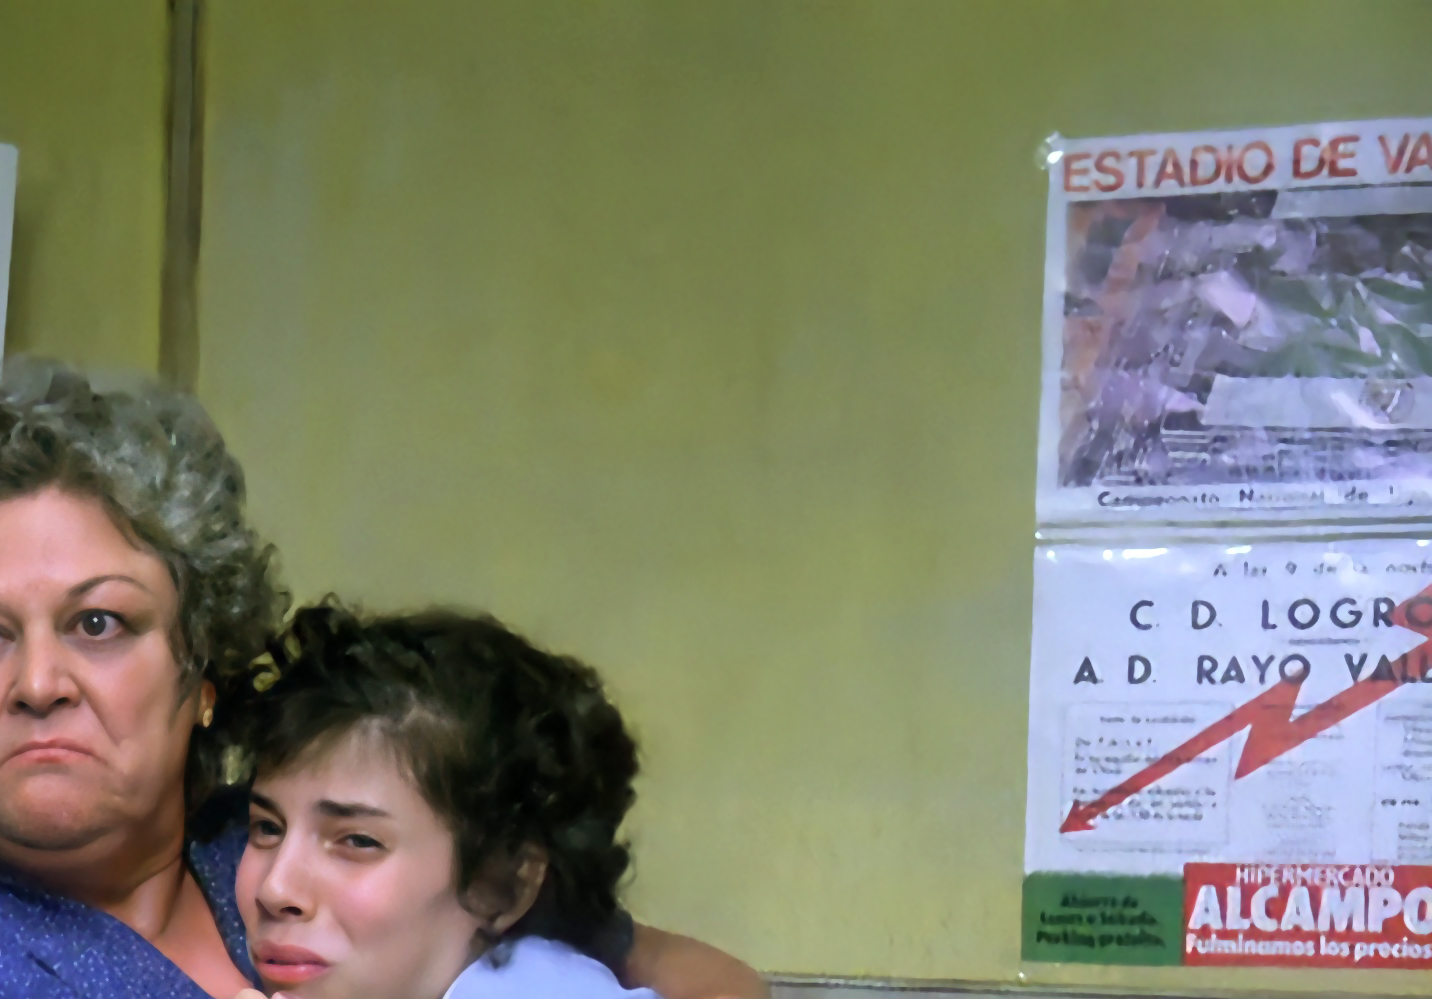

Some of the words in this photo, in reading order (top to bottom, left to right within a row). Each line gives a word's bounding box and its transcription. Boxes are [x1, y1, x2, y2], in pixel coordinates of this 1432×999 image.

[1063, 141, 1276, 193] ESTADIO
[1292, 135, 1361, 179] DE
[1129, 599, 1160, 631] C.
[1190, 599, 1223, 630] D.
[1073, 655, 1104, 685] A.
[1126, 655, 1158, 685] D.
[1196, 652, 1312, 685] RAYO
[1235, 865, 1395, 888] HIPERMERCADO
[1187, 884, 1432, 935] ALCAMPO
[1319, 934, 1350, 957] los
